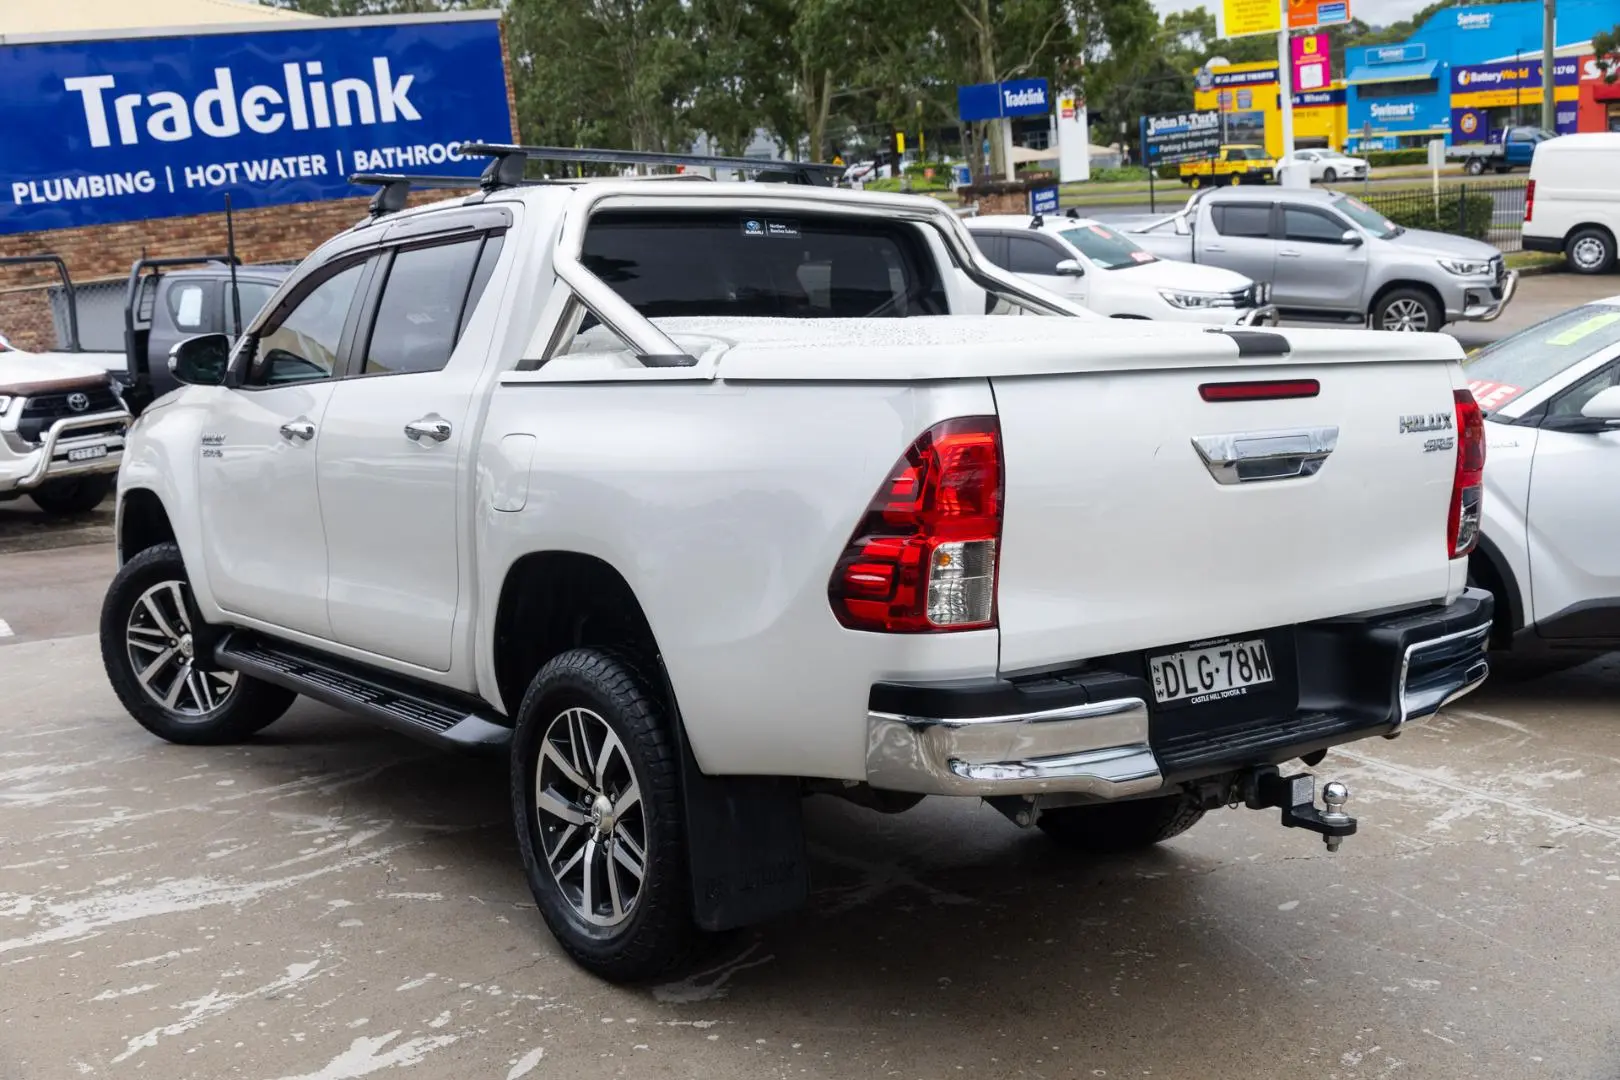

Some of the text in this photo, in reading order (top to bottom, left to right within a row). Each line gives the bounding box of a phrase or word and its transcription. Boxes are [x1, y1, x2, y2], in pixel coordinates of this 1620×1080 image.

[64, 56, 422, 148] Tradelink
[1004, 87, 1045, 107] Tradelink
[1189, 111, 1219, 130] Turk
[12, 170, 156, 205] PLUMBING
[184, 162, 240, 188] HOT
[241, 154, 328, 182] WATER
[1399, 412, 1453, 434] HILUX
[1191, 694, 1210, 704] CASTLE
[1209, 692, 1221, 701] HILL
[1220, 689, 1241, 698] TOYOTA
